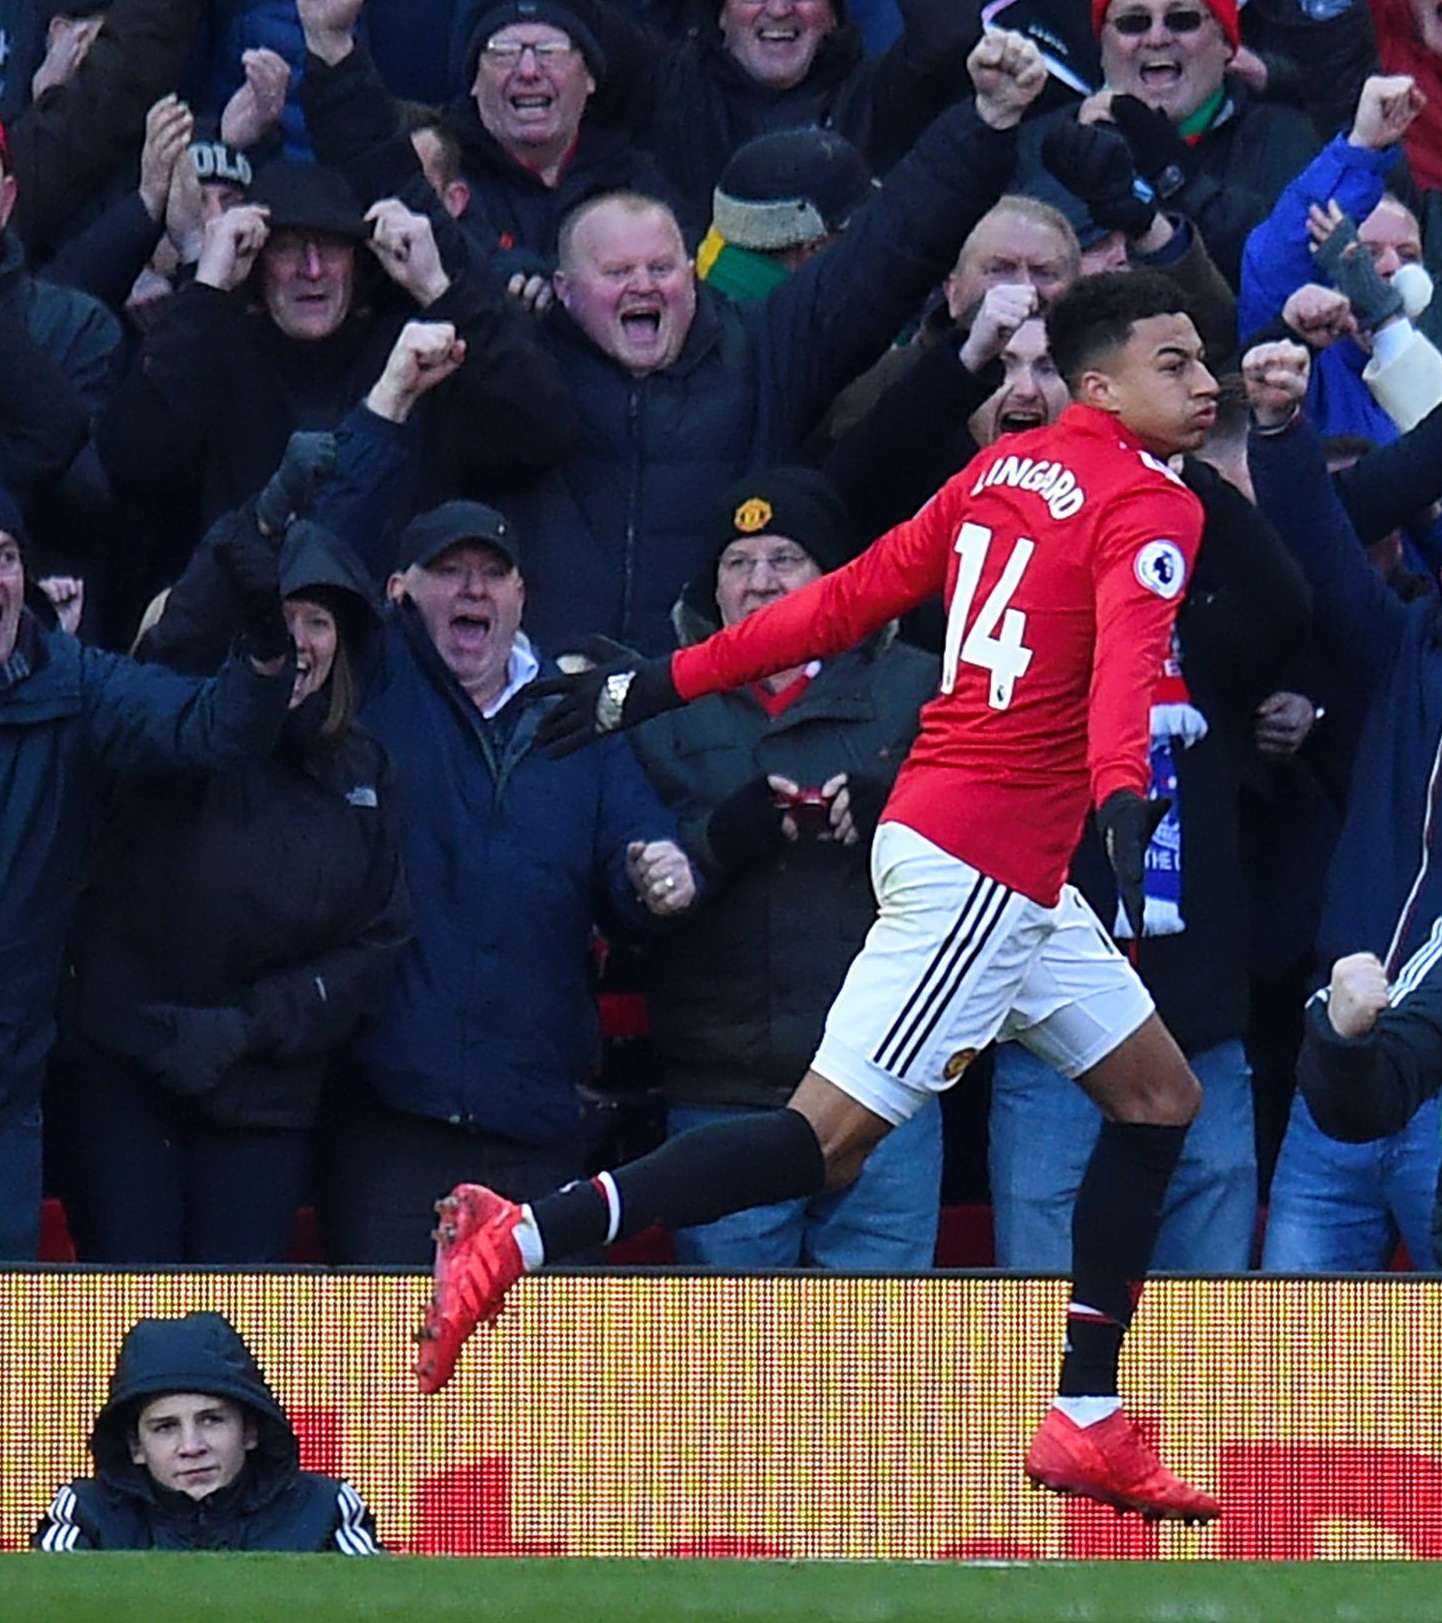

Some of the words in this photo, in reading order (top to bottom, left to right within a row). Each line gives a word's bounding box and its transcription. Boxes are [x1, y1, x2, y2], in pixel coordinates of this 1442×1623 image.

[187, 143, 252, 185] OLO
[970, 455, 1085, 520] LINGARD
[940, 521, 1036, 711] 14
